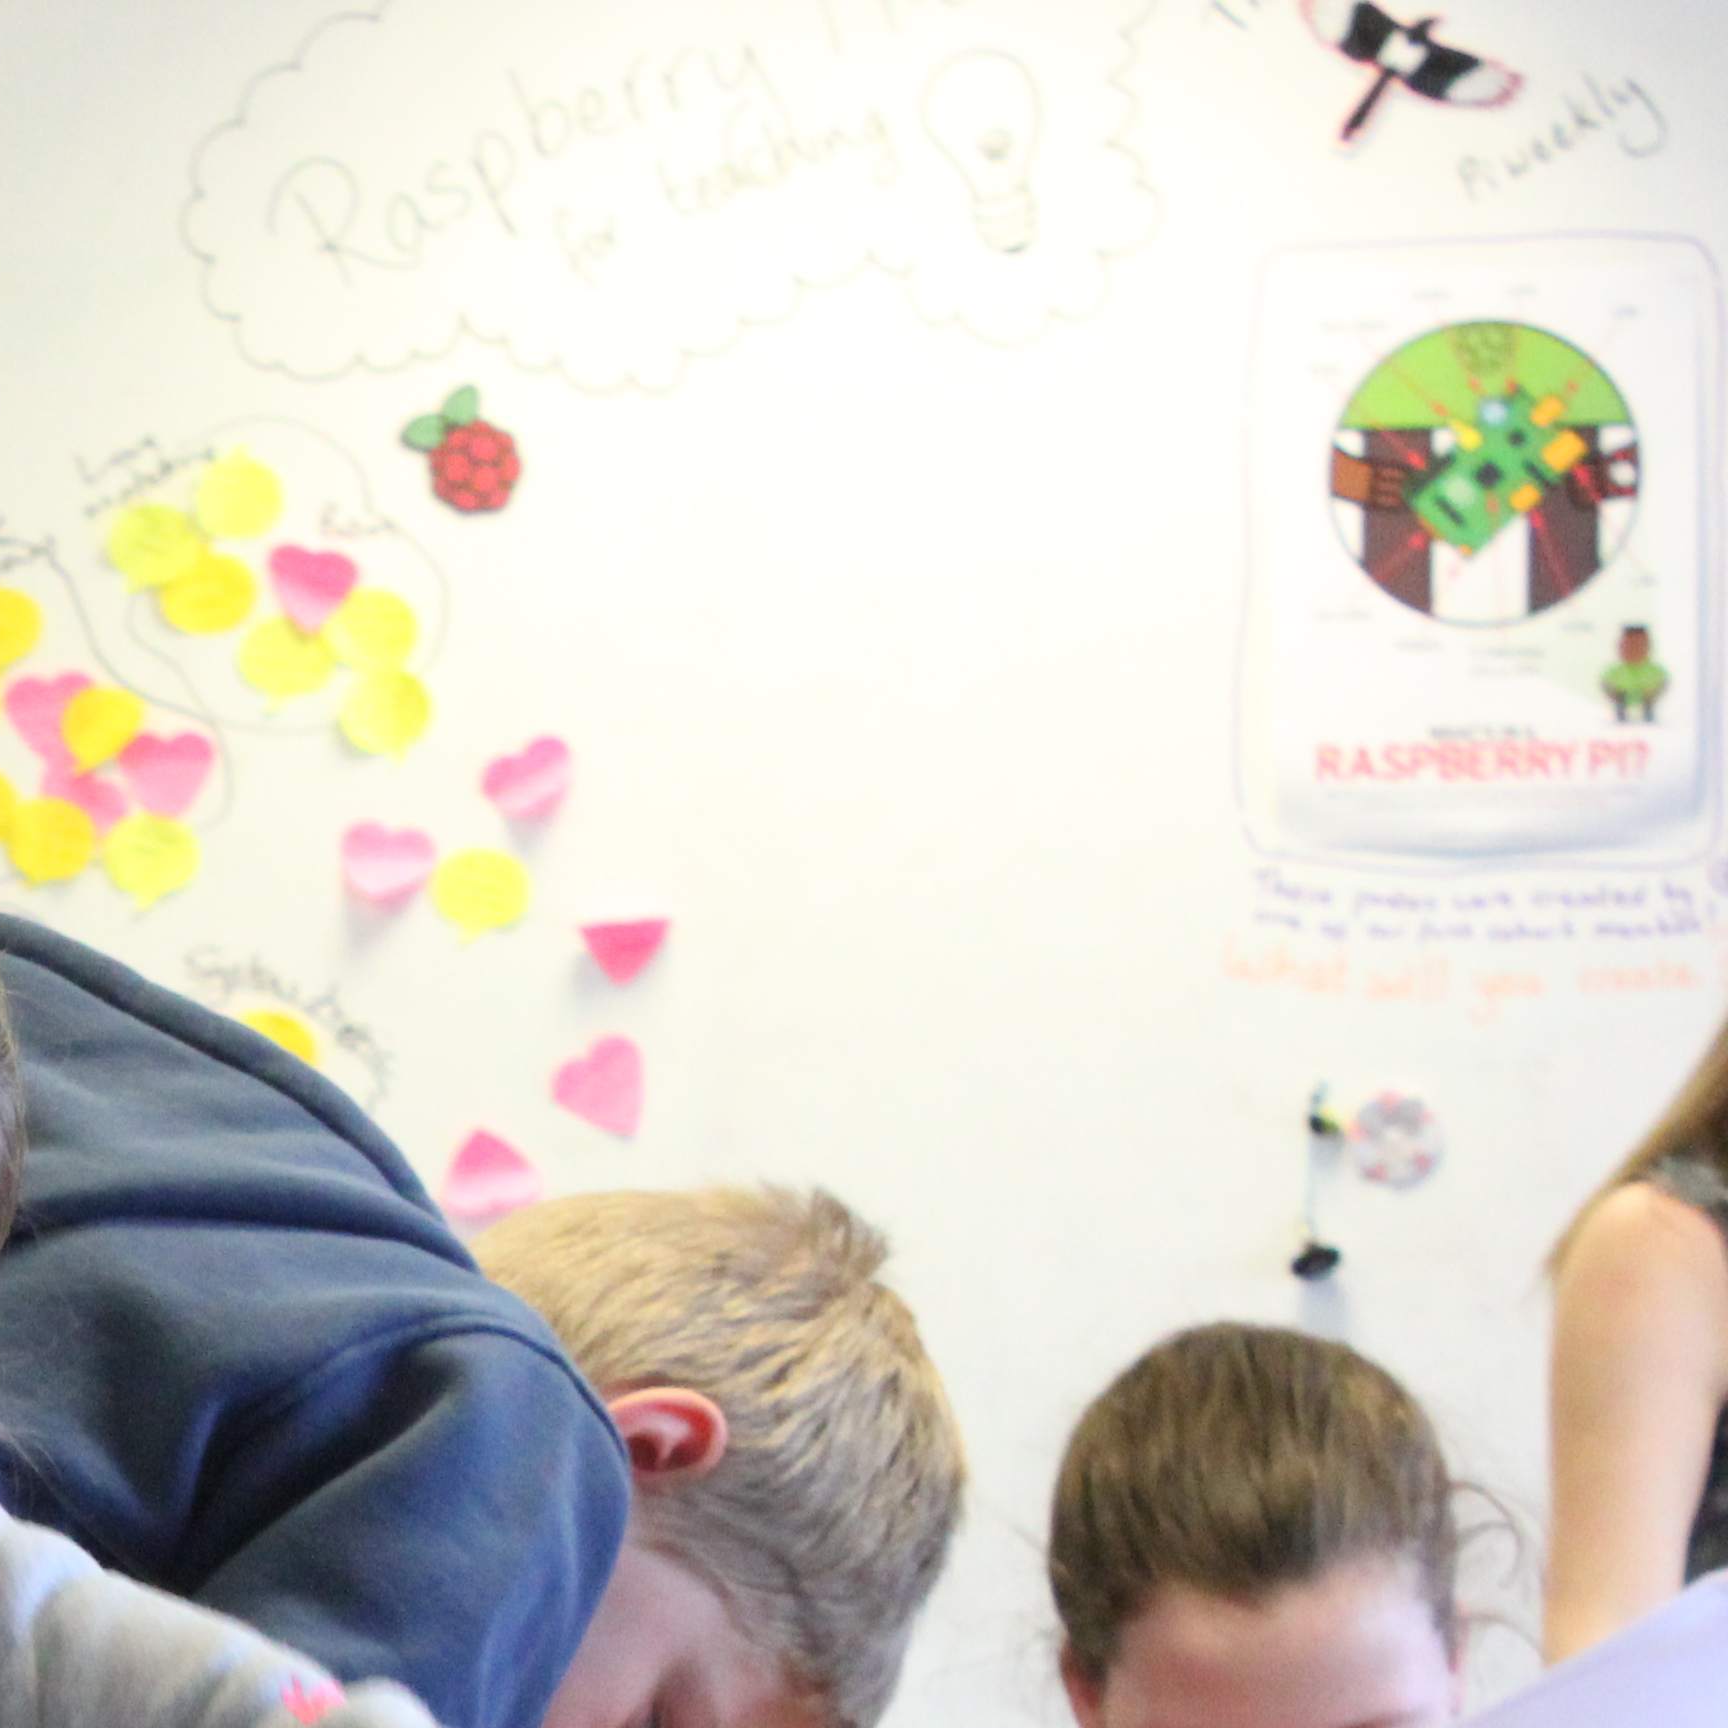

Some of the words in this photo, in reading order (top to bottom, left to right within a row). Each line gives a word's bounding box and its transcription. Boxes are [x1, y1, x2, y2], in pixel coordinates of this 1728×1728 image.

[264, 42, 810, 290] Raspberry
[1314, 740, 1575, 783] RASPBERRY
[1588, 738, 1650, 779] PI?
